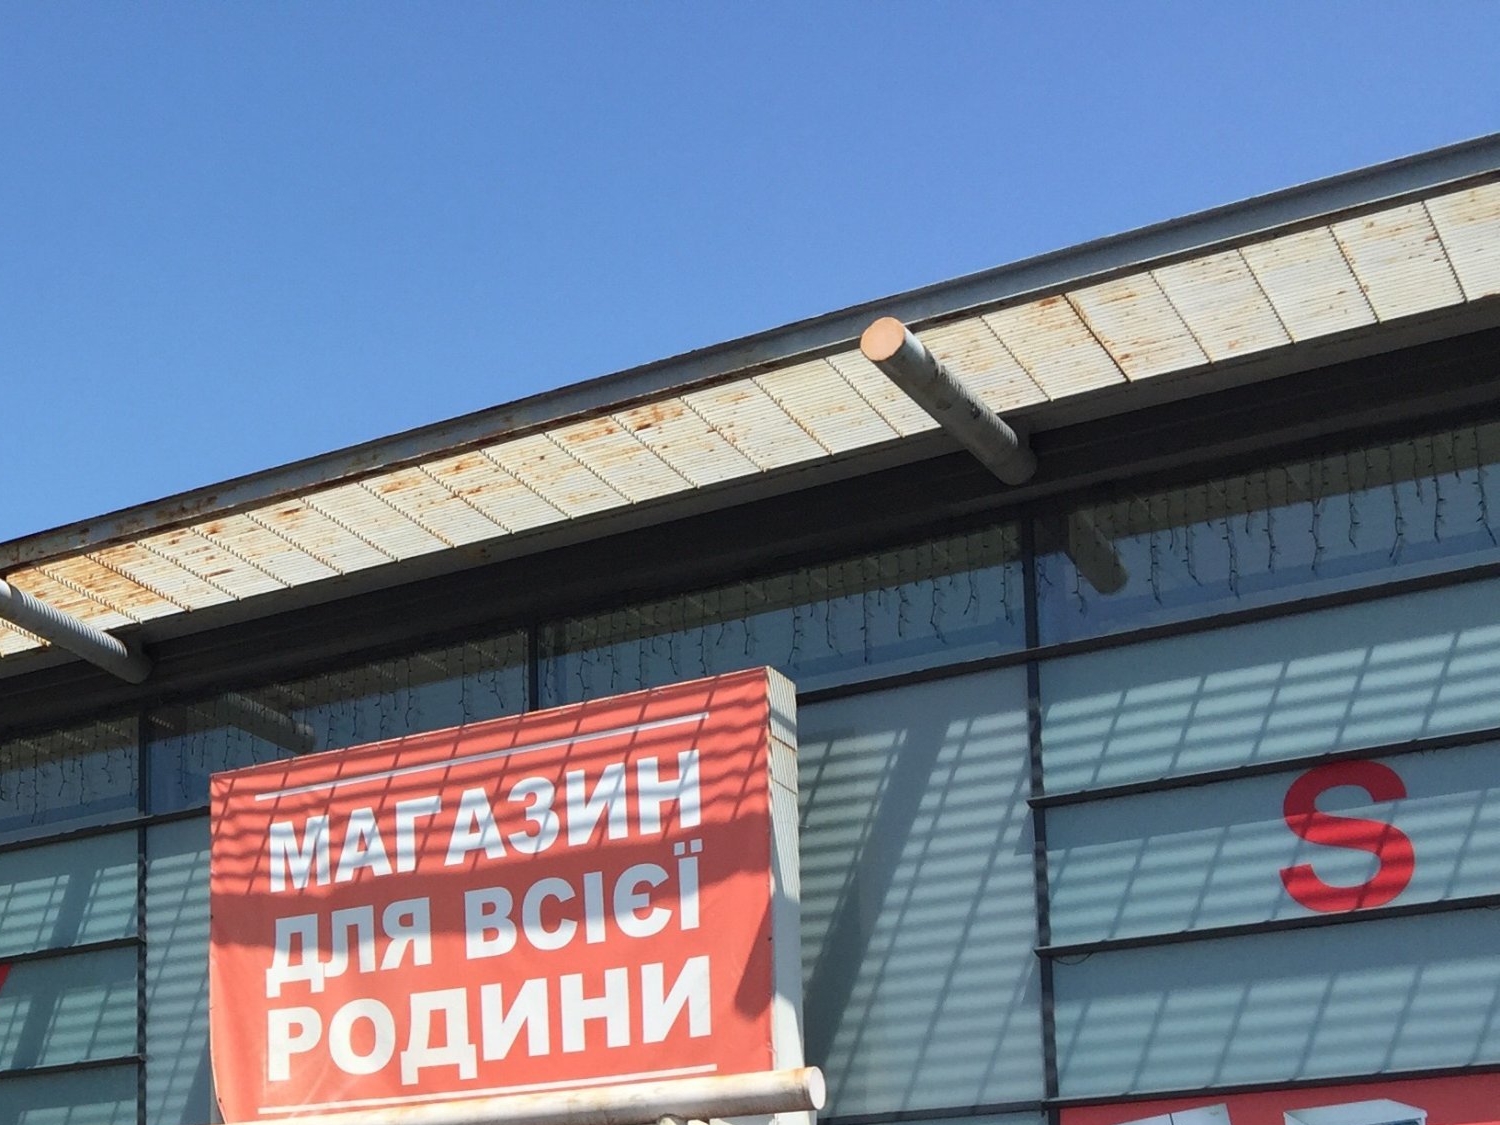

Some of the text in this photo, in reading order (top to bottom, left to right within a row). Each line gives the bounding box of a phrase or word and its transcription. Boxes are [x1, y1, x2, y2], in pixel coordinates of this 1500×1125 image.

[268, 748, 702, 893] МАГАЗИН
[265, 839, 705, 999] ДЛЯ ВСІЄЇ
[266, 955, 712, 1086] РОДИНИ
